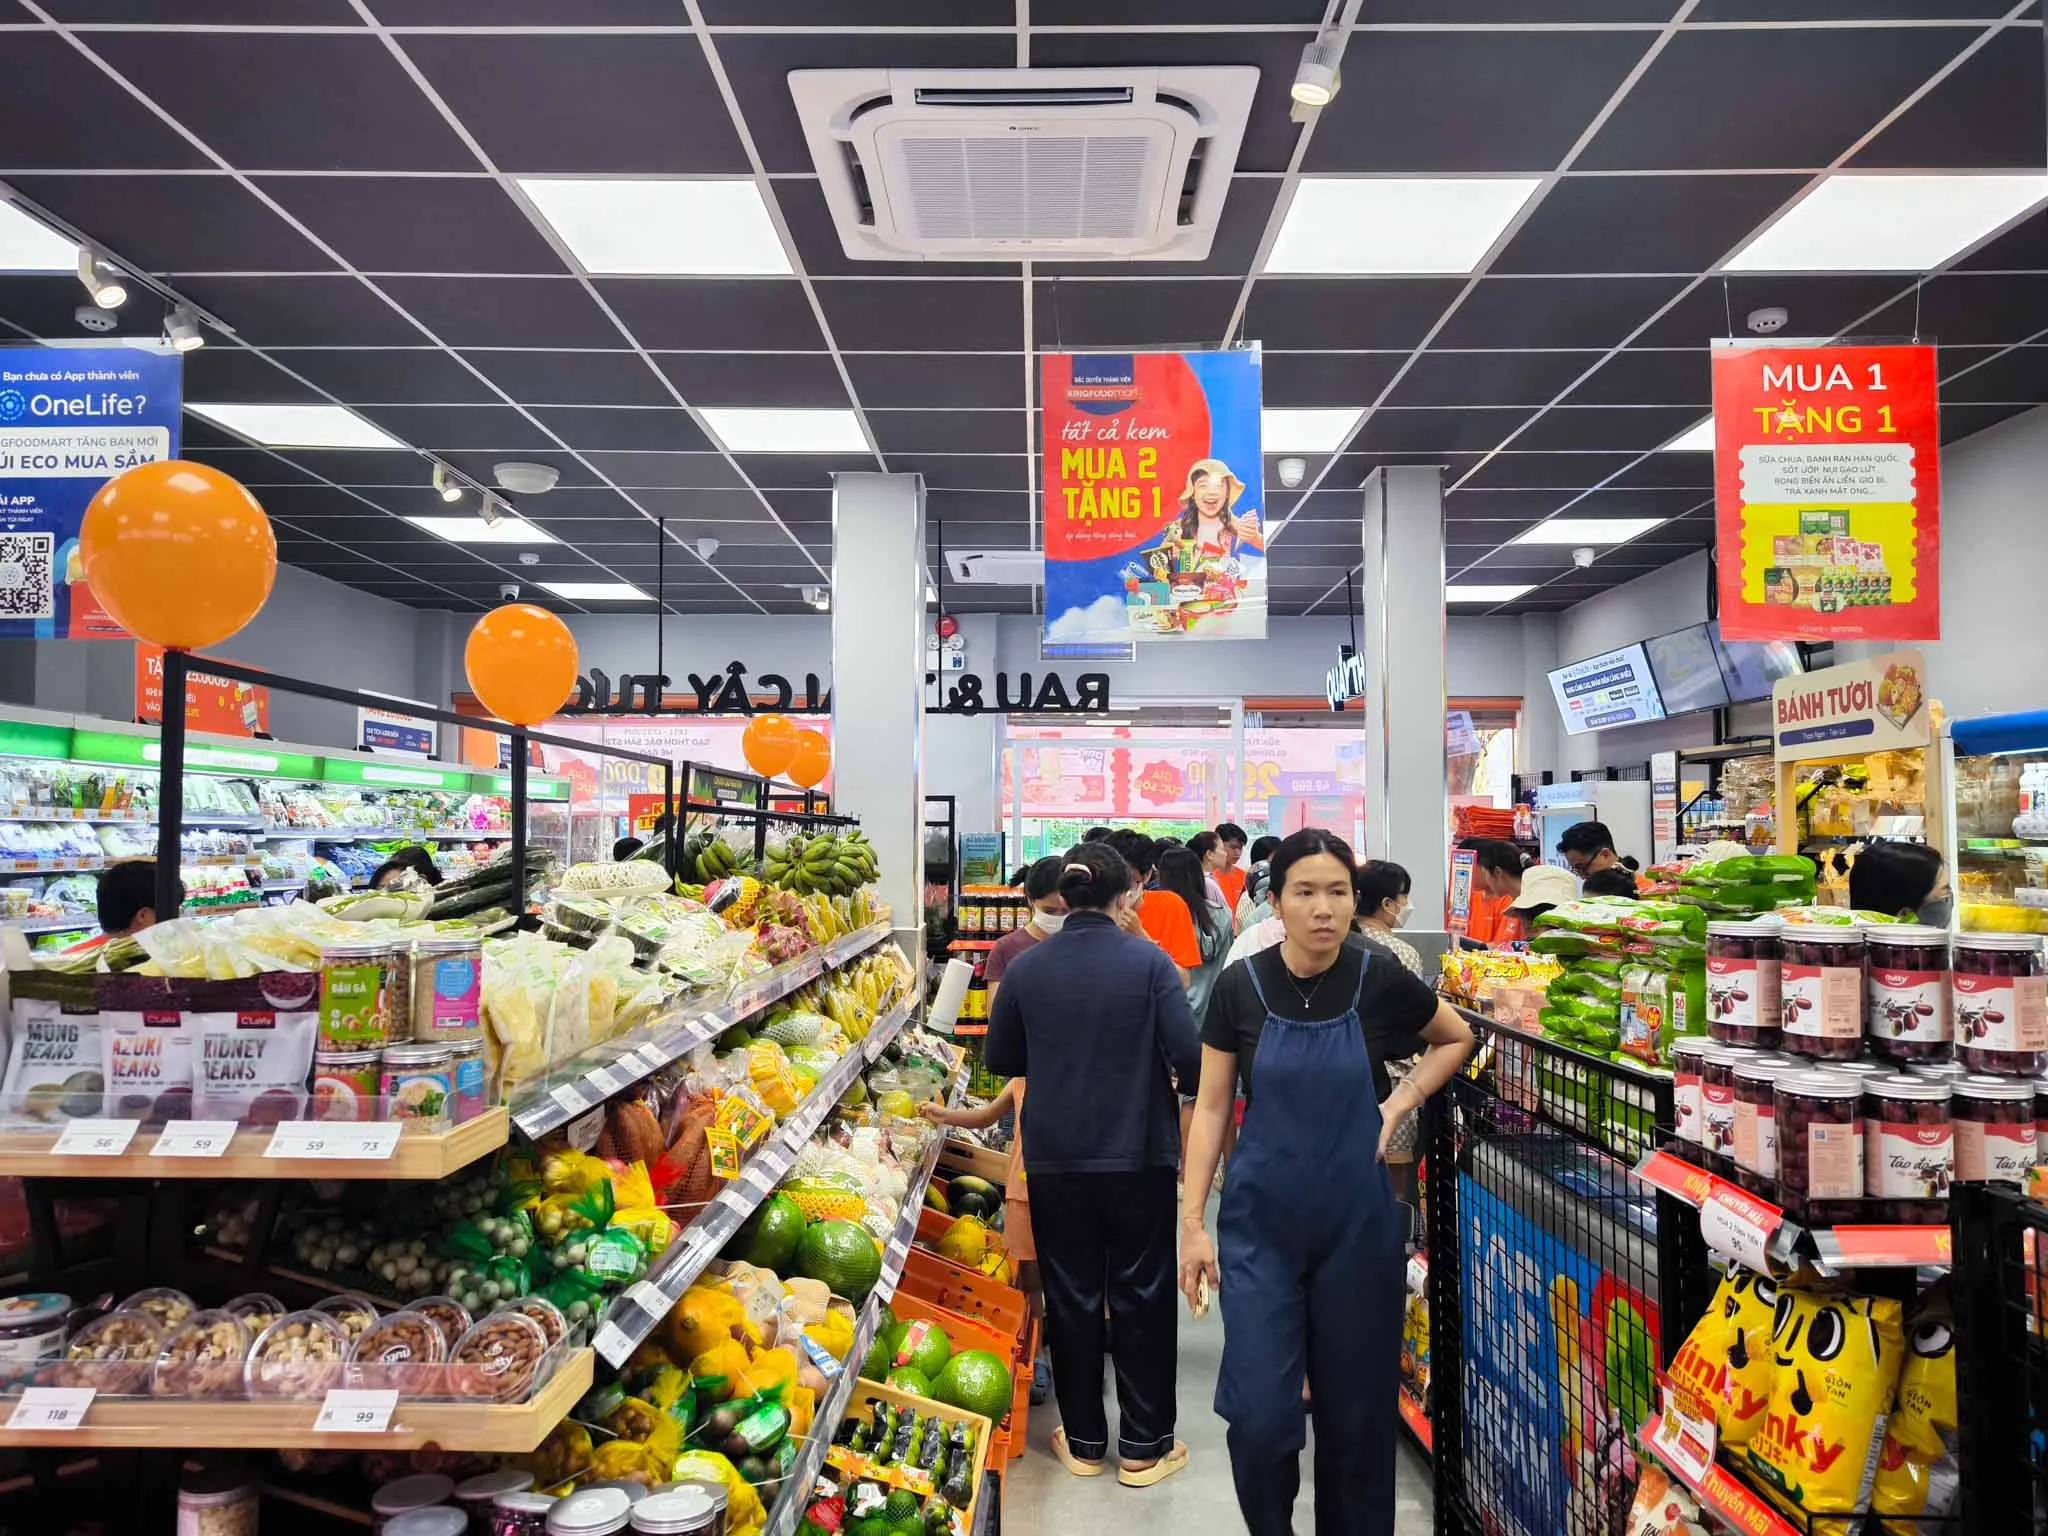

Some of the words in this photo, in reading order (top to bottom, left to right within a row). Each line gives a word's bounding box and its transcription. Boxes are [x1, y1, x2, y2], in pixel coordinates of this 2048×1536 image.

[64, 371, 85, 382] App
[1762, 364, 1853, 391] MUA
[1867, 363, 1887, 390] 1
[31, 393, 147, 416] OneLife?
[1753, 399, 1862, 440] TẶNG
[1876, 405, 1897, 433] 1
[1097, 418, 1120, 440] cả
[1126, 417, 1172, 440] kem
[21, 454, 58, 469] ECO
[65, 454, 108, 469] MUA
[1061, 447, 1127, 480] MUA
[1138, 446, 1157, 479] 2
[11, 495, 35, 505] APP
[1062, 480, 1142, 527] TẶNG
[1152, 486, 1161, 518] 1
[1777, 690, 1824, 724] BÁNH
[1827, 680, 1873, 715] TƯƠI
[1884, 974, 1908, 984] nutty
[28, 1023, 79, 1042] MUNG
[203, 1039, 267, 1059] KIDNEY
[94, 1138, 113, 1148] 56
[1917, 1130, 1941, 1141] nutty
[193, 1140, 212, 1150] 59
[306, 1141, 325, 1151] 59
[362, 1141, 379, 1151] 73
[355, 1411, 374, 1423] 99
